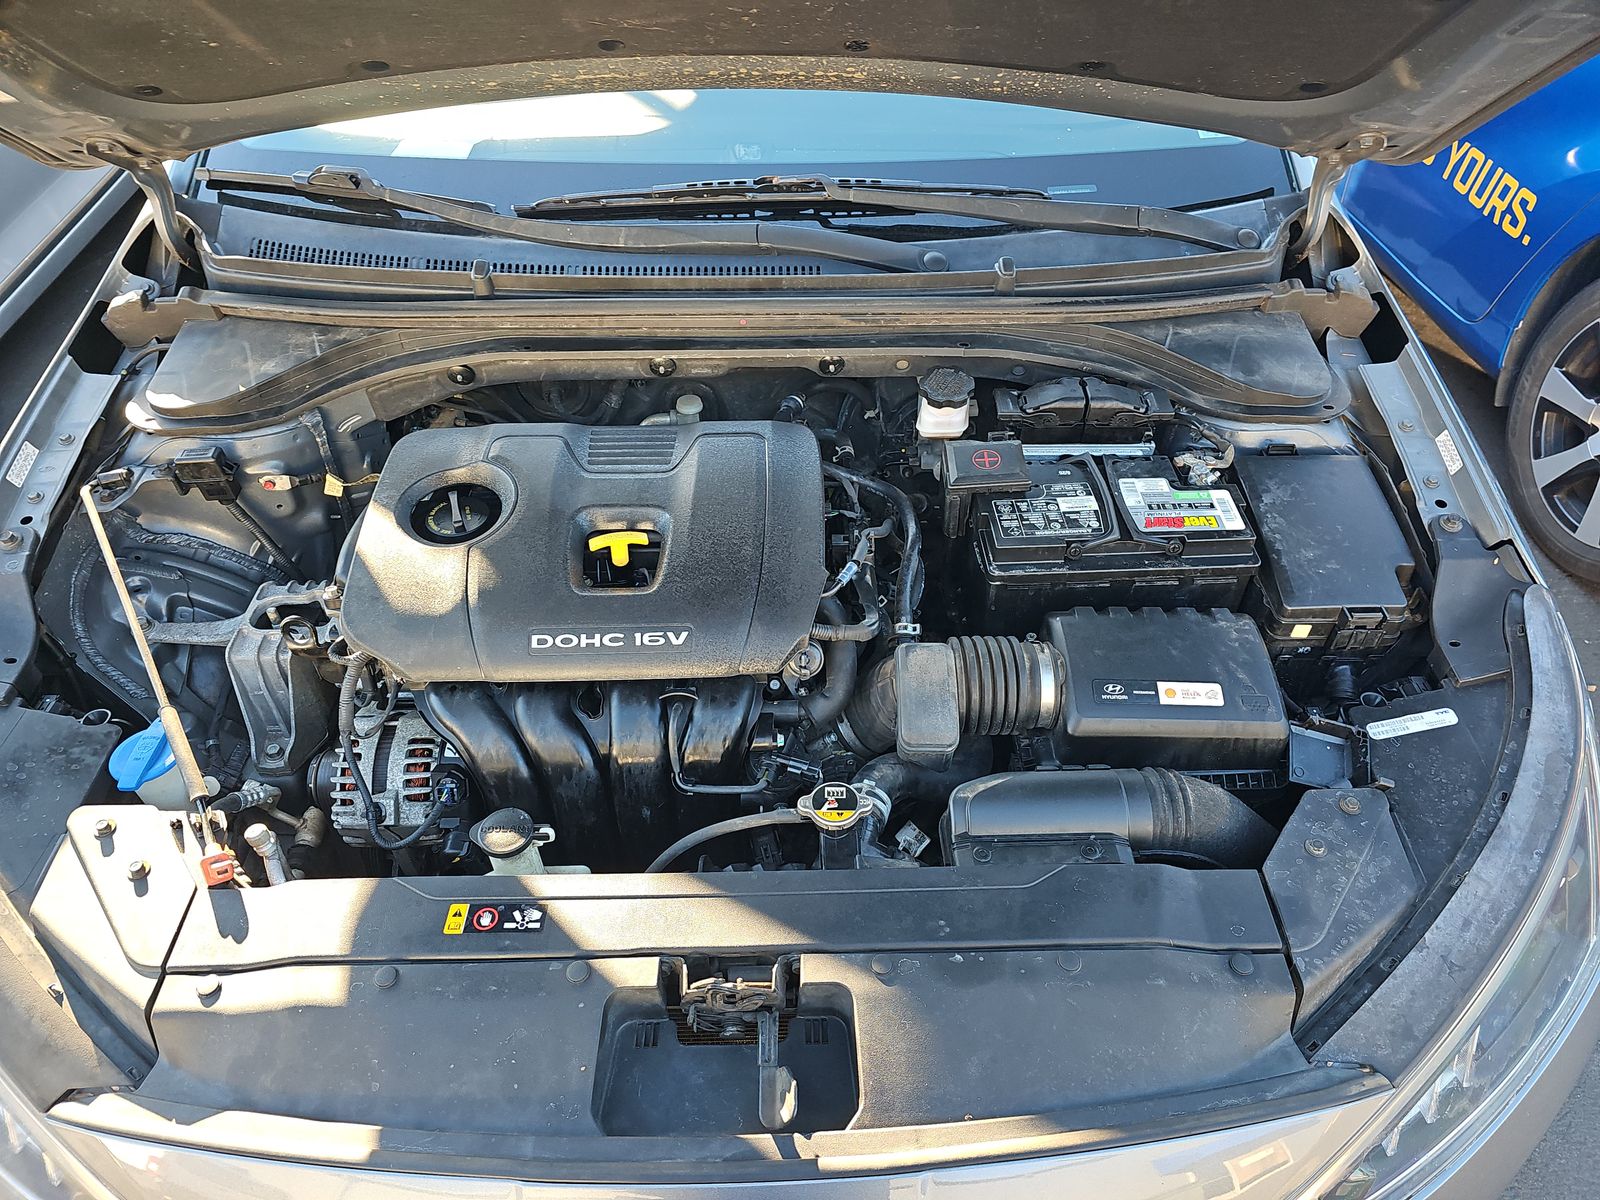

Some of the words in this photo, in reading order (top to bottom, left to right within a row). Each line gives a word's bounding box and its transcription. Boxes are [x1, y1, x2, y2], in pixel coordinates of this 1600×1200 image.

[1442, 140, 1538, 247] YOURS.
[1144, 515, 1219, 529] EverStart
[531, 633, 625, 648] DOHC
[634, 631, 689, 646] 16V
[480, 823, 530, 834] COOLANT
